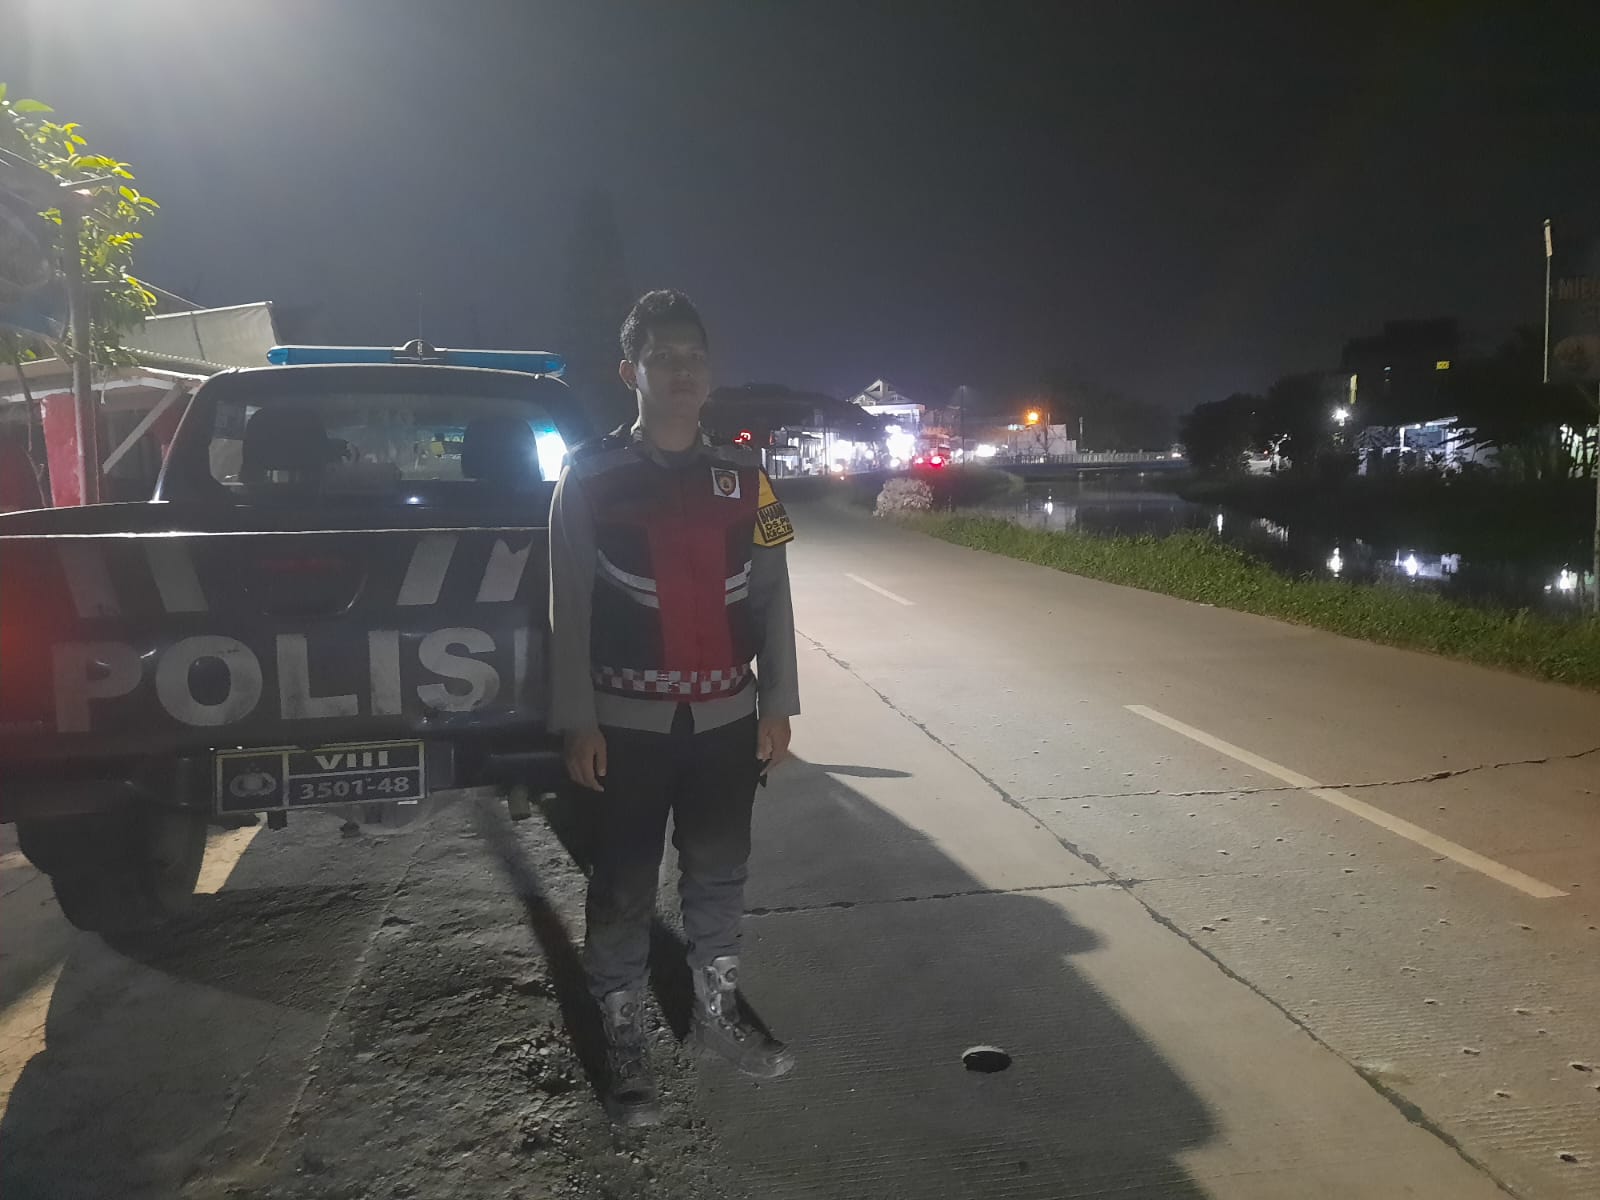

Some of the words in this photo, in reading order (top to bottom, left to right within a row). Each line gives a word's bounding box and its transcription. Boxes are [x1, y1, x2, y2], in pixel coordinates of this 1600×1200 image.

[52, 627, 541, 734] POLISI
[314, 750, 389, 770] VIII
[299, 776, 410, 801] 3501-48
